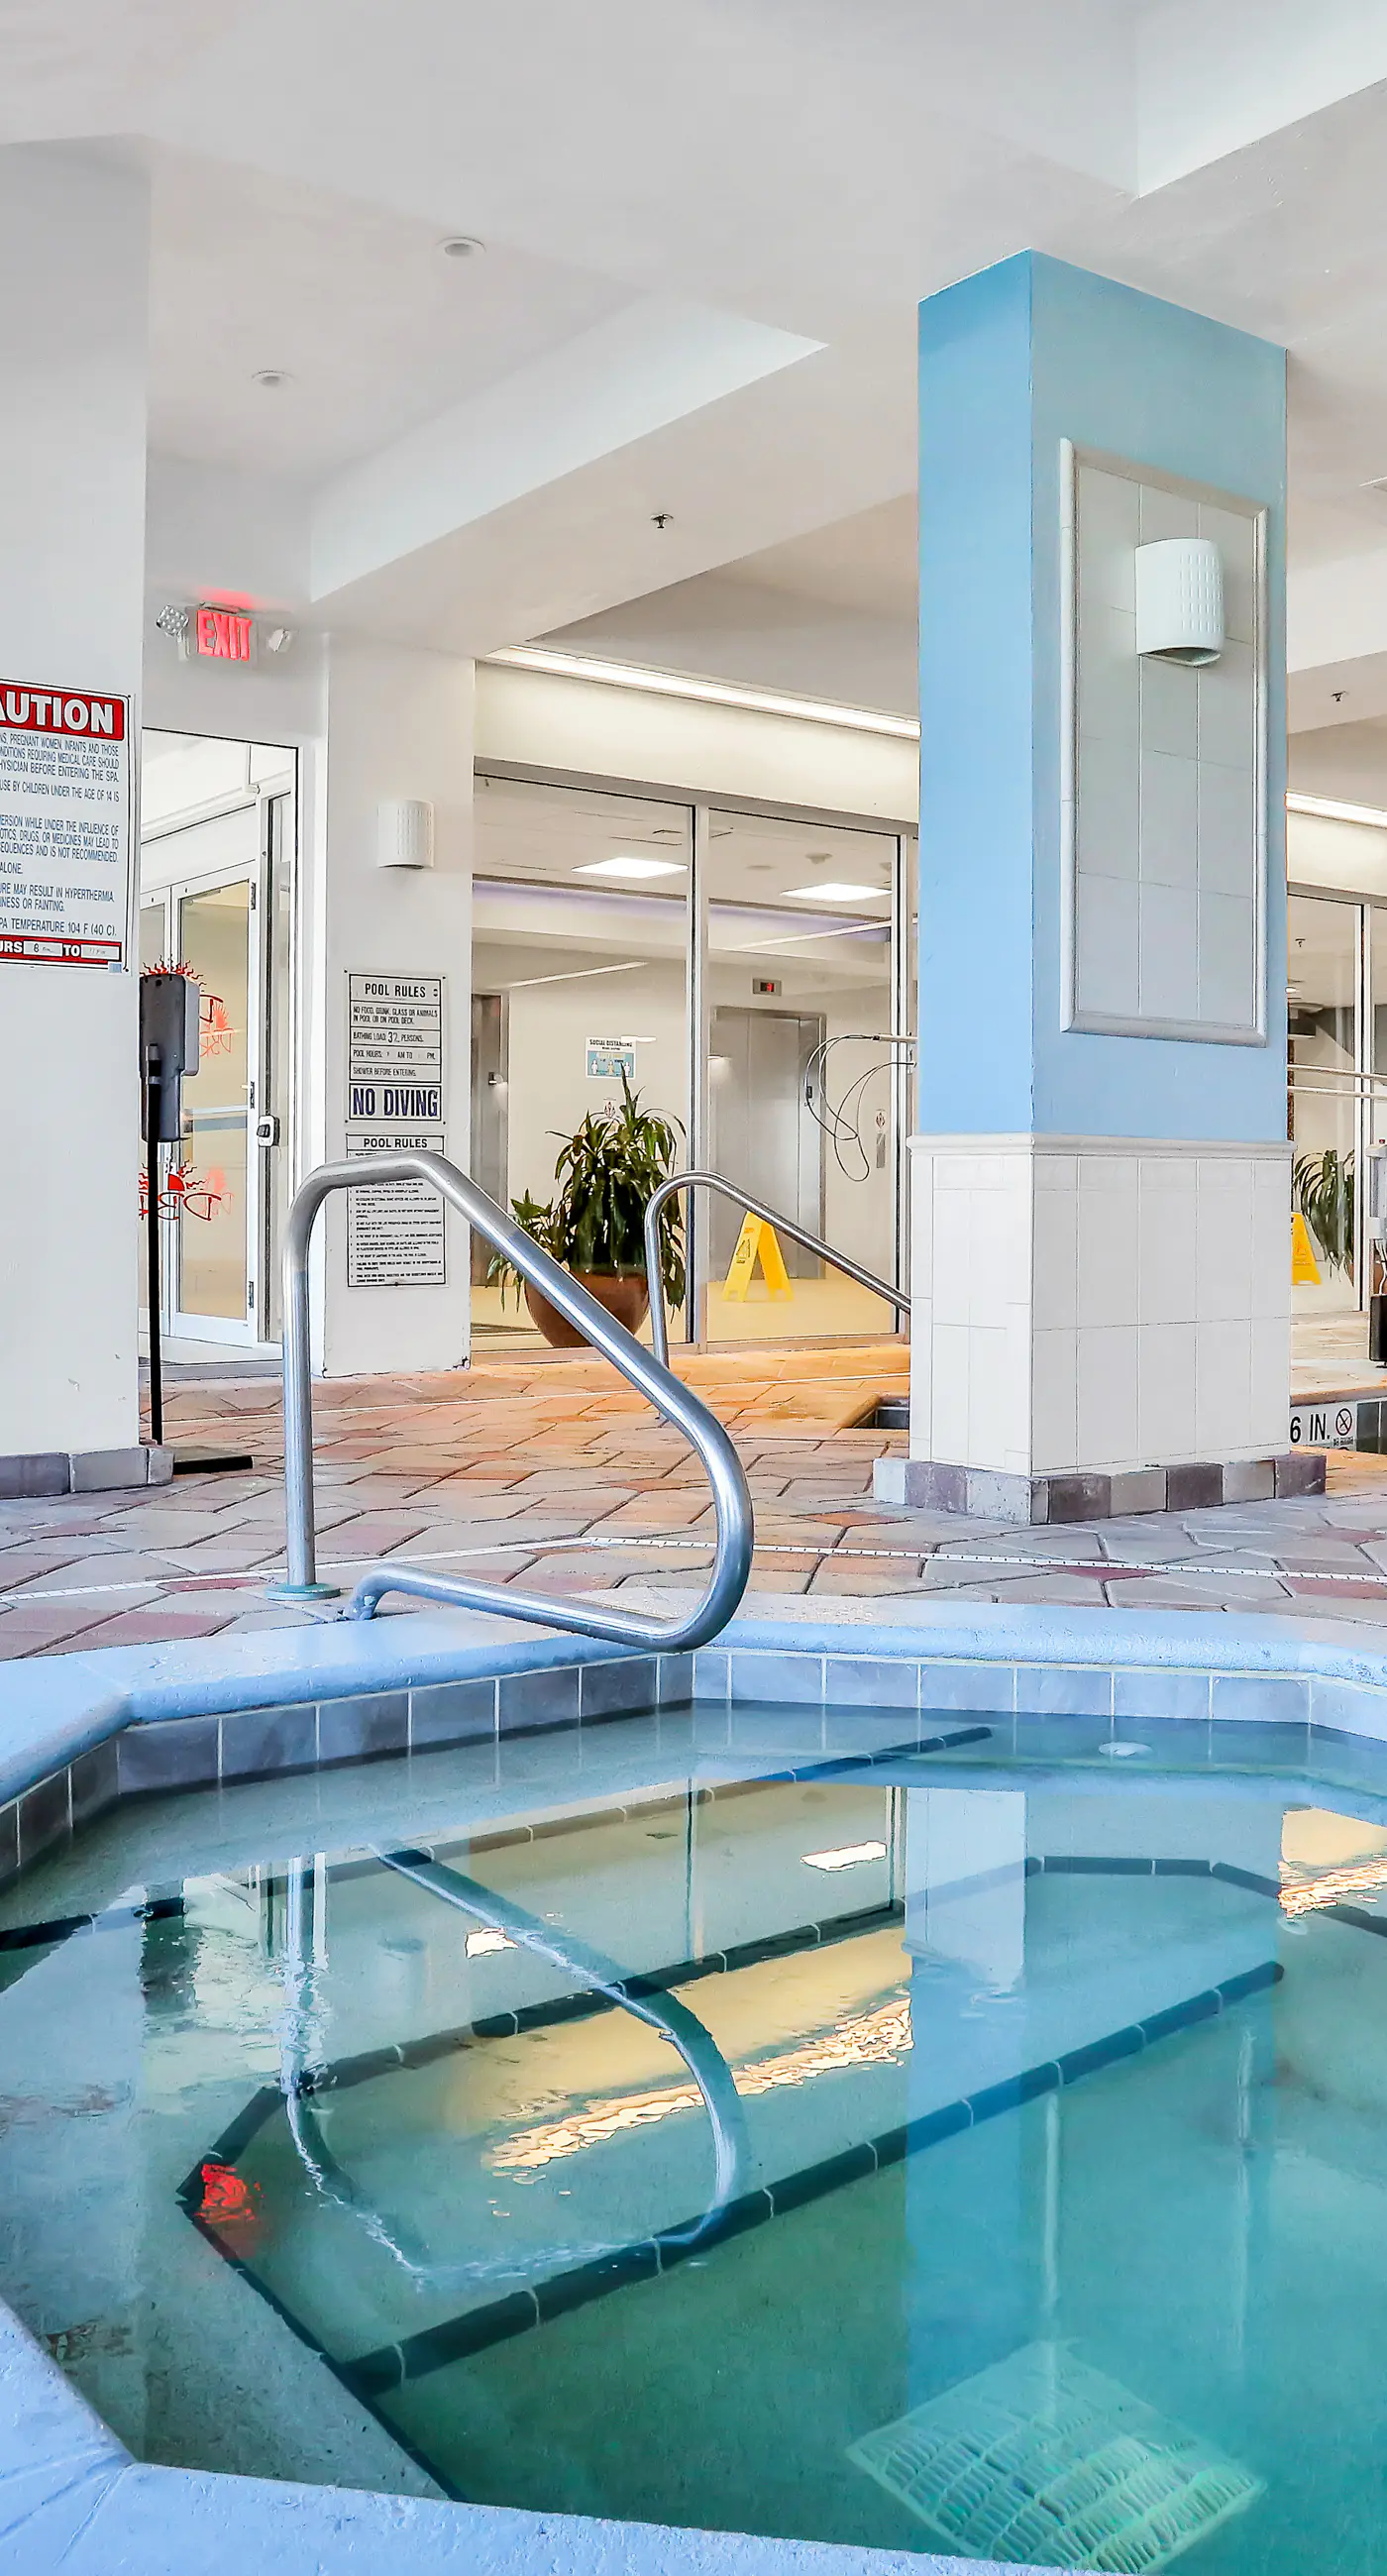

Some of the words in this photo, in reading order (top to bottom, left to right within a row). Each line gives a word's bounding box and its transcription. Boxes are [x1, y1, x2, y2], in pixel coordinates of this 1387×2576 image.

[197, 609, 252, 661] EXIT
[0, 690, 113, 734] UTION
[10, 733, 39, 747] PREGNANT
[65, 740, 86, 753] INFANTS
[88, 743, 100, 754] AND
[101, 744, 118, 756] THOSE
[27, 749, 56, 763] REQUIRING
[58, 752, 80, 765] MEDICAL
[82, 755, 96, 767] CARE
[98, 757, 119, 769] SHOULD
[30, 762, 56, 775] BEFORE
[58, 765, 90, 779] ENTERING
[92, 769, 104, 781] THE
[106, 771, 119, 782] SPA.
[12, 780, 20, 792] BY
[22, 782, 50, 795] CHILDREN
[51, 784, 70, 797] UNDER
[72, 787, 82, 798] THE
[84, 788, 95, 800] AGE
[97, 789, 105, 801] OF
[107, 790, 112, 802] 14
[113, 791, 119, 802] IS
[24, 816, 42, 829] WHILE
[44, 818, 64, 831] UNDER
[66, 820, 76, 832] THE
[79, 822, 109, 835] INFLUENCE
[110, 824, 119, 836] OF
[42, 832, 50, 843] OR
[52, 833, 82, 846] MEDICINES
[83, 836, 95, 847] MAY
[96, 837, 109, 849] LEAD
[112, 838, 119, 850] TO
[36, 844, 48, 857] AND
[50, 846, 56, 858] IS
[58, 847, 70, 859] NOT
[72, 848, 118, 862] RECOMMENDED.
[13, 883, 27, 895] MAY
[29, 885, 54, 898] RESULT
[56, 887, 63, 898] IN
[22, 898, 32, 909] OR
[34, 899, 65, 912] FAINTING.
[11, 918, 65, 933] TEMPERATURE
[68, 922, 80, 934] 104
[84, 923, 88, 934] F
[91, 923, 103, 936] (40
[107, 924, 117, 936] C).
[33, 943, 39, 952] 8
[63, 945, 80, 957] TO
[365, 983, 389, 996] POOL
[395, 985, 426, 998] RULES
[353, 1032, 372, 1040] BATHING
[353, 1067, 373, 1075] SHOWER
[353, 1088, 375, 1116] NO
[384, 1089, 437, 1117] DIVING
[364, 1138, 391, 1148] POOL
[395, 1138, 427, 1148] RULES
[1290, 1416, 1301, 1443] 6
[1309, 1413, 1330, 1441] IN.
